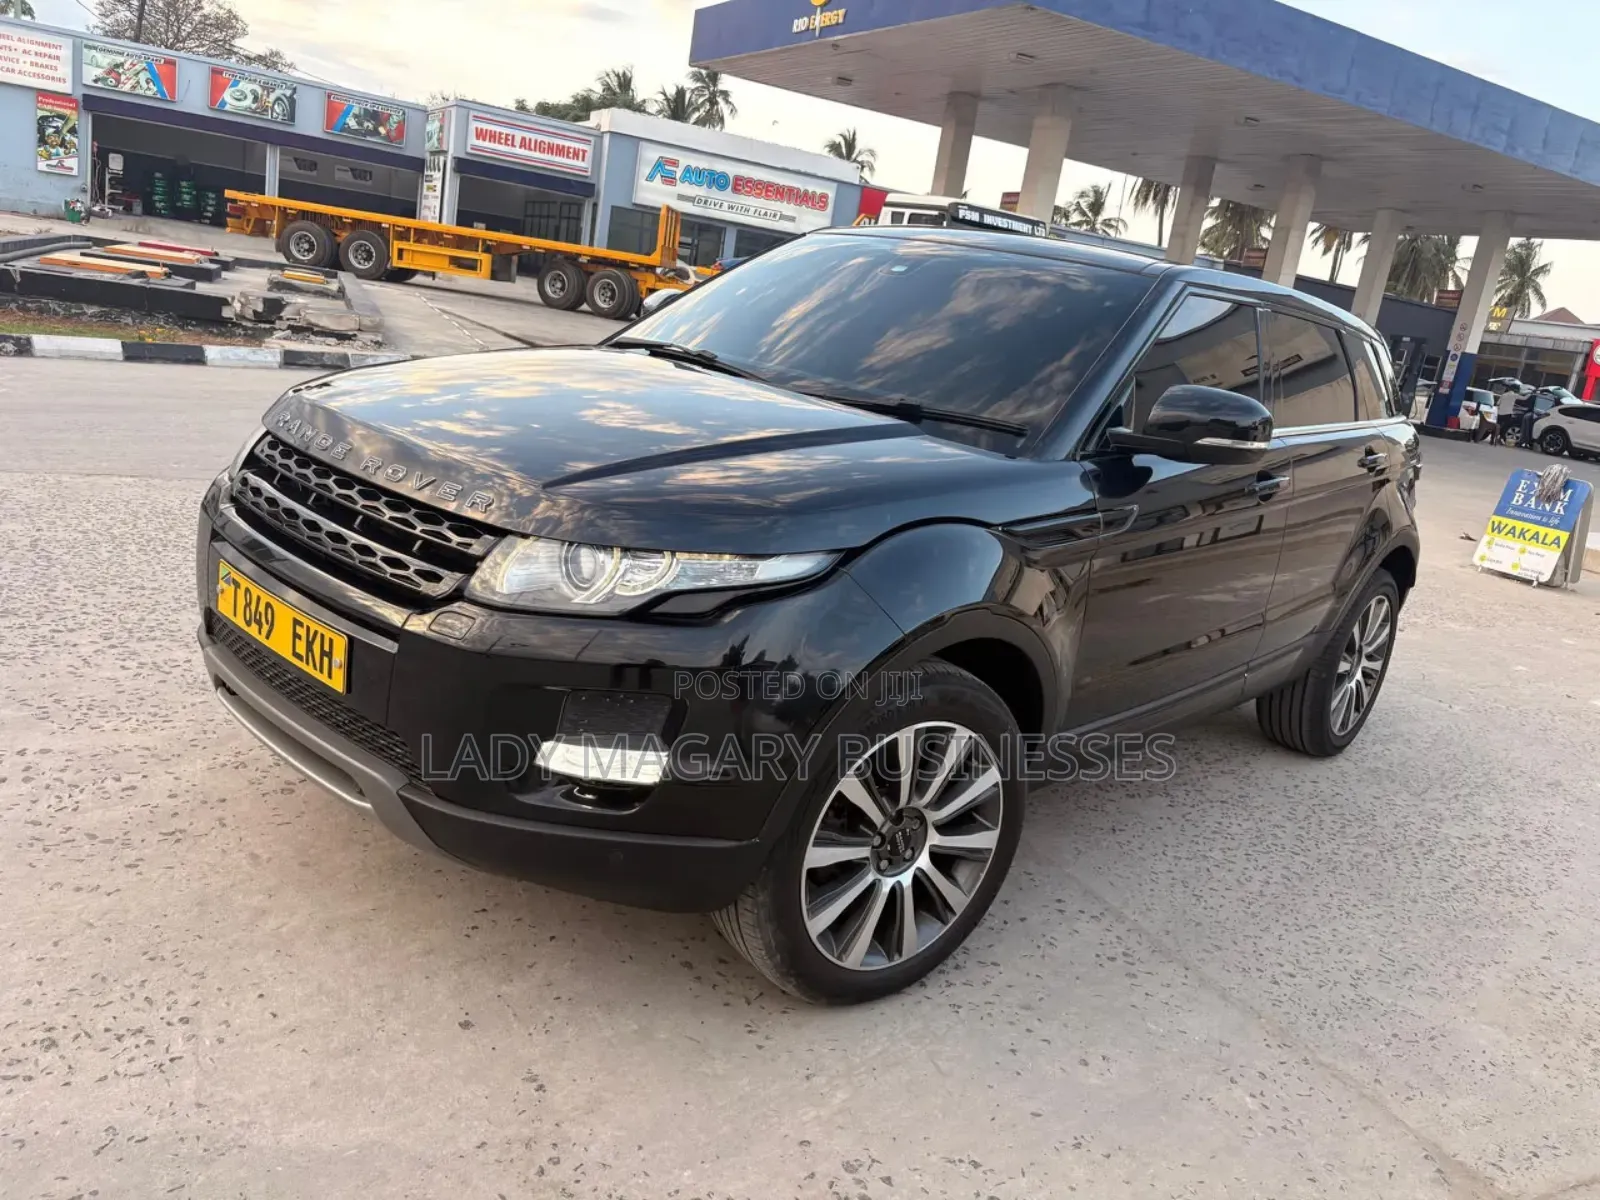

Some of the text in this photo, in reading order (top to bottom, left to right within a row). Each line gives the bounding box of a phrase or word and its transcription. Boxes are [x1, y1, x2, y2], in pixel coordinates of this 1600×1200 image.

[792, 16, 809, 33] RIO
[17, 36, 63, 51] ALIGNMENT
[22, 48, 33, 56] AC
[34, 51, 61, 62] REPAIR
[17, 69, 67, 84] ACCESSORIES
[29, 60, 59, 72] BRAKES
[474, 126, 588, 162] WHEEL ALIGNMENT
[679, 165, 830, 212] AUTO ESSENTIALS
[696, 197, 779, 220] DRIVE WITH FLAIR
[983, 214, 1033, 234] INVESTMENT
[276, 410, 495, 514] RANGE ROVER
[1510, 492, 1569, 515] BANK
[1490, 520, 1561, 549] WAKALA
[292, 616, 335, 680] EKH
